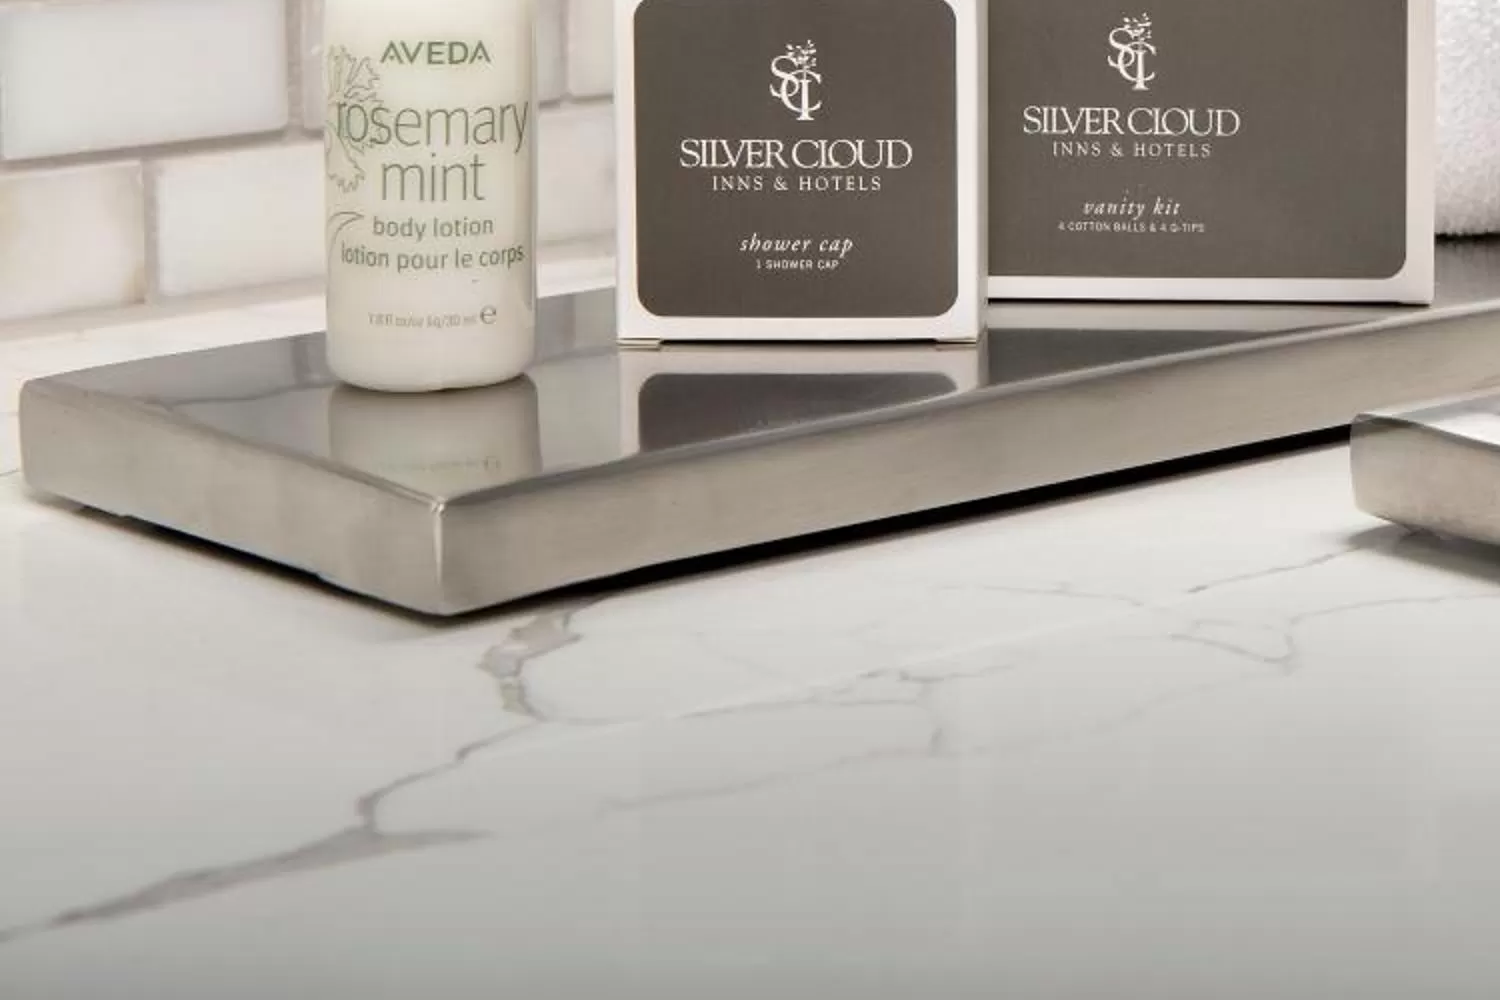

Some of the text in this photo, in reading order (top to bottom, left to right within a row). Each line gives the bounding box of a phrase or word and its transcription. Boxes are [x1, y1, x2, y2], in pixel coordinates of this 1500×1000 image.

[380, 40, 492, 65] AVEDA
[336, 101, 529, 154] rosemary
[1022, 105, 1241, 136] SILVER CLOUD
[679, 138, 913, 169] SILVER CLOUD
[1052, 140, 1213, 158] INNS & HOTELS
[381, 152, 486, 201] mint
[712, 175, 881, 191] INNS & HOTELS
[1082, 195, 1181, 220] vanity kit
[372, 215, 494, 243] body lotion
[1067, 221, 1111, 231] COTTON
[1113, 221, 1146, 232] BALLS
[341, 240, 526, 273] lotion pour le corps
[740, 232, 853, 258] shower cap
[765, 259, 813, 270] SHOWER
[817, 259, 839, 271] CAP
